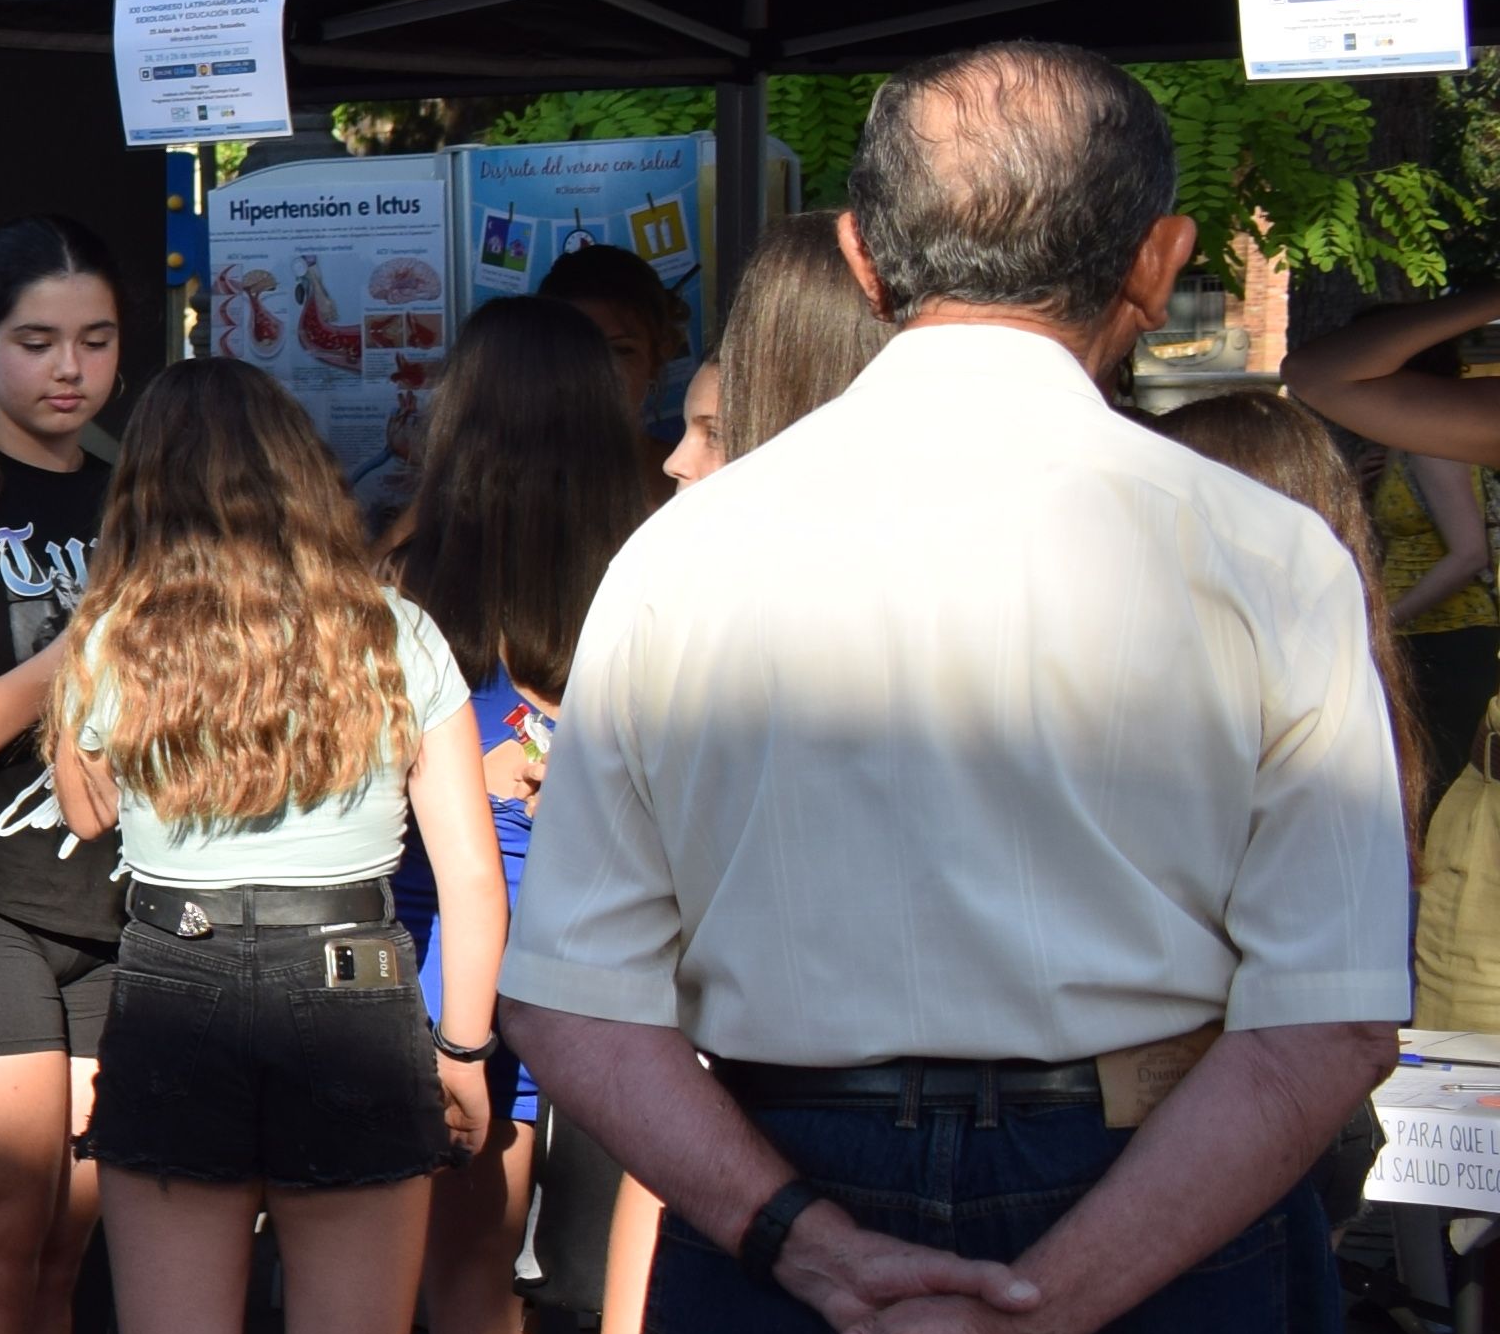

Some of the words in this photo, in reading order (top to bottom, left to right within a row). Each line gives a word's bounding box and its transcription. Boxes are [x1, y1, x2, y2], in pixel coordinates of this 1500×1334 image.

[142, 2, 183, 14] CONGRESO
[185, 8, 229, 20] EDUCACIÓN
[231, 6, 260, 15] SEXUAL
[481, 154, 537, 181] Disfruta
[541, 155, 563, 176] del
[566, 161, 608, 175] verano
[613, 161, 636, 172] con
[640, 149, 682, 172] salud
[230, 196, 351, 227] Hipertensión
[358, 201, 370, 215] e
[376, 194, 421, 215] Ictus
[1397, 1120, 1443, 1149] PARA
[1450, 1125, 1484, 1155] QUE
[1490, 1129, 1499, 1155] L
[1393, 1157, 1450, 1187] SALUD
